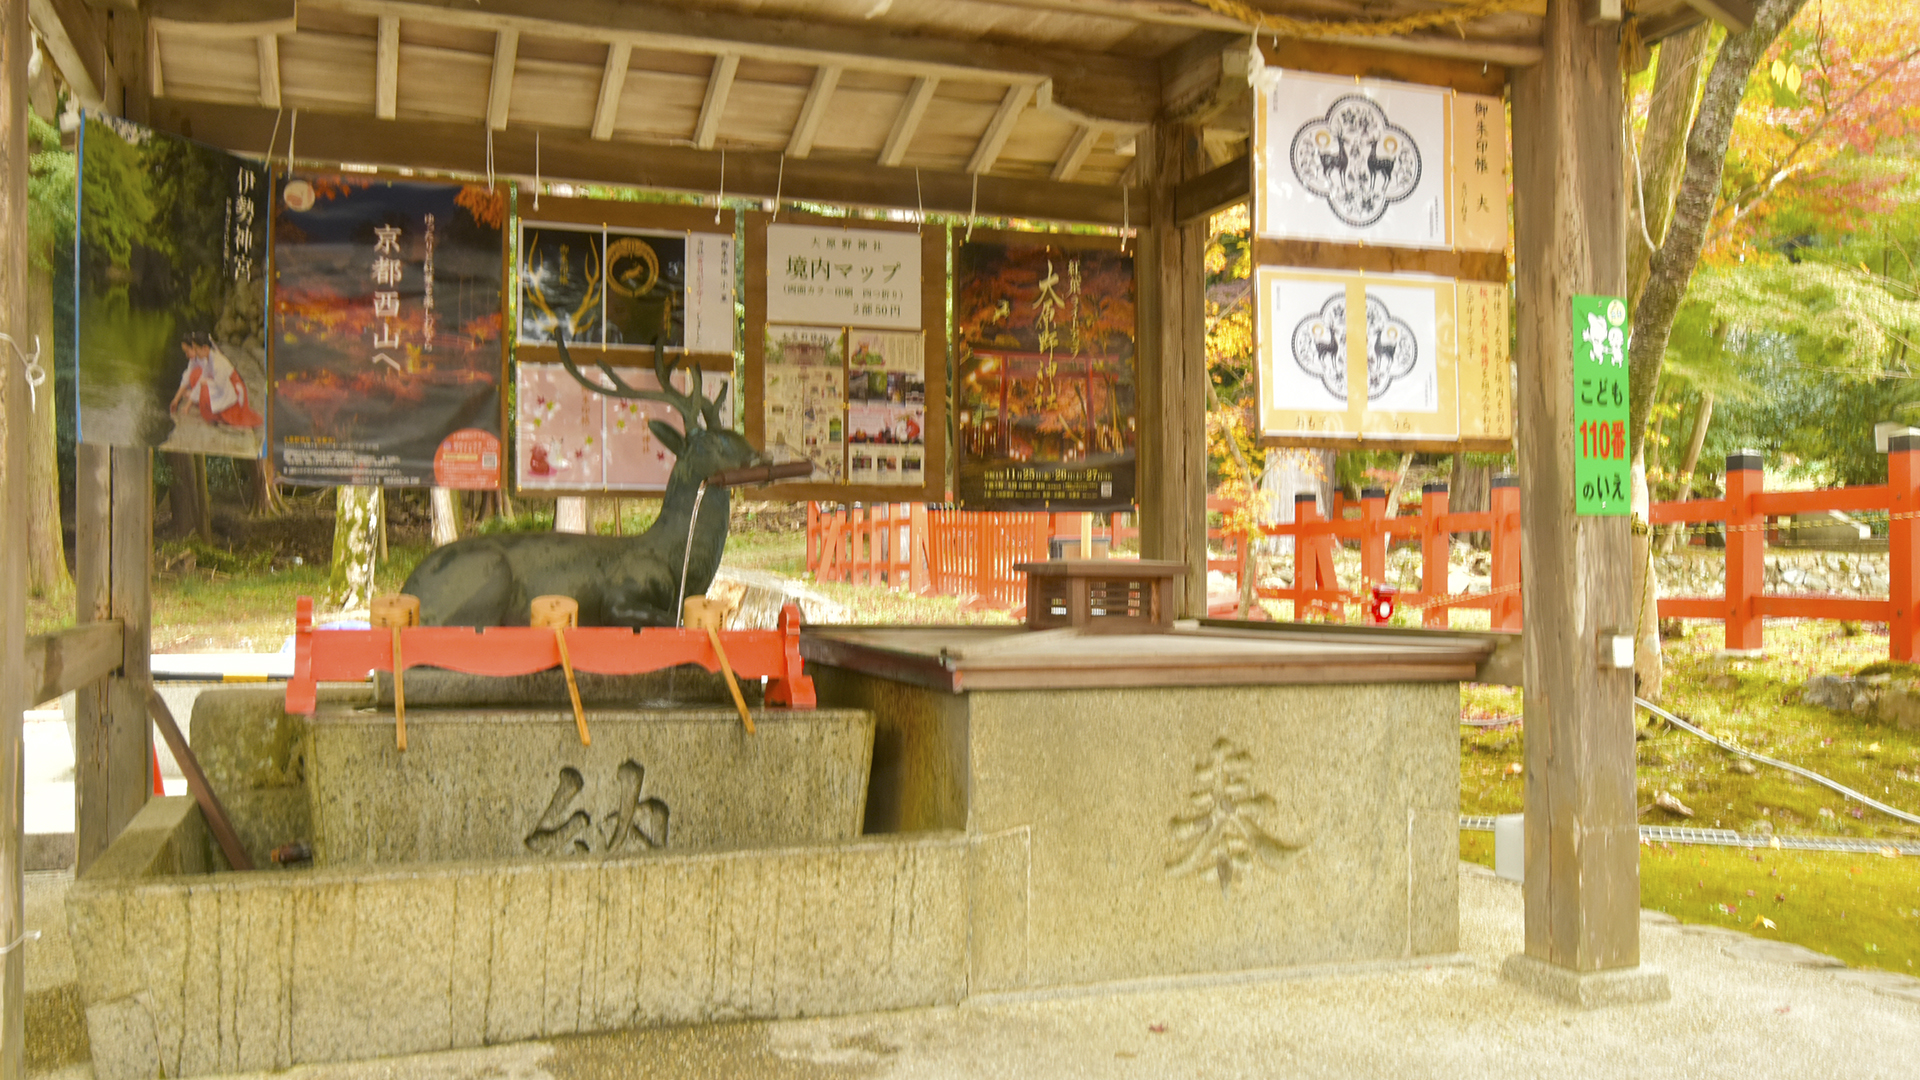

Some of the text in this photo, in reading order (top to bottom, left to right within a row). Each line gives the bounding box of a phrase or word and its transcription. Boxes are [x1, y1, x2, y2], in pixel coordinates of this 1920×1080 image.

[1474, 100, 1490, 213] 御朱印帳 大
[234, 166, 256, 282] 伊勢神宮
[811, 236, 882, 252] 大原野神社
[371, 223, 402, 371] 京都西山へ
[786, 254, 901, 284] 境内マップ
[1032, 259, 1066, 414] 大原野神社
[1581, 378, 1623, 407] こども
[1579, 419, 1626, 460] 110番
[1582, 472, 1624, 500] のいえ
[1163, 736, 1312, 896] 奉
